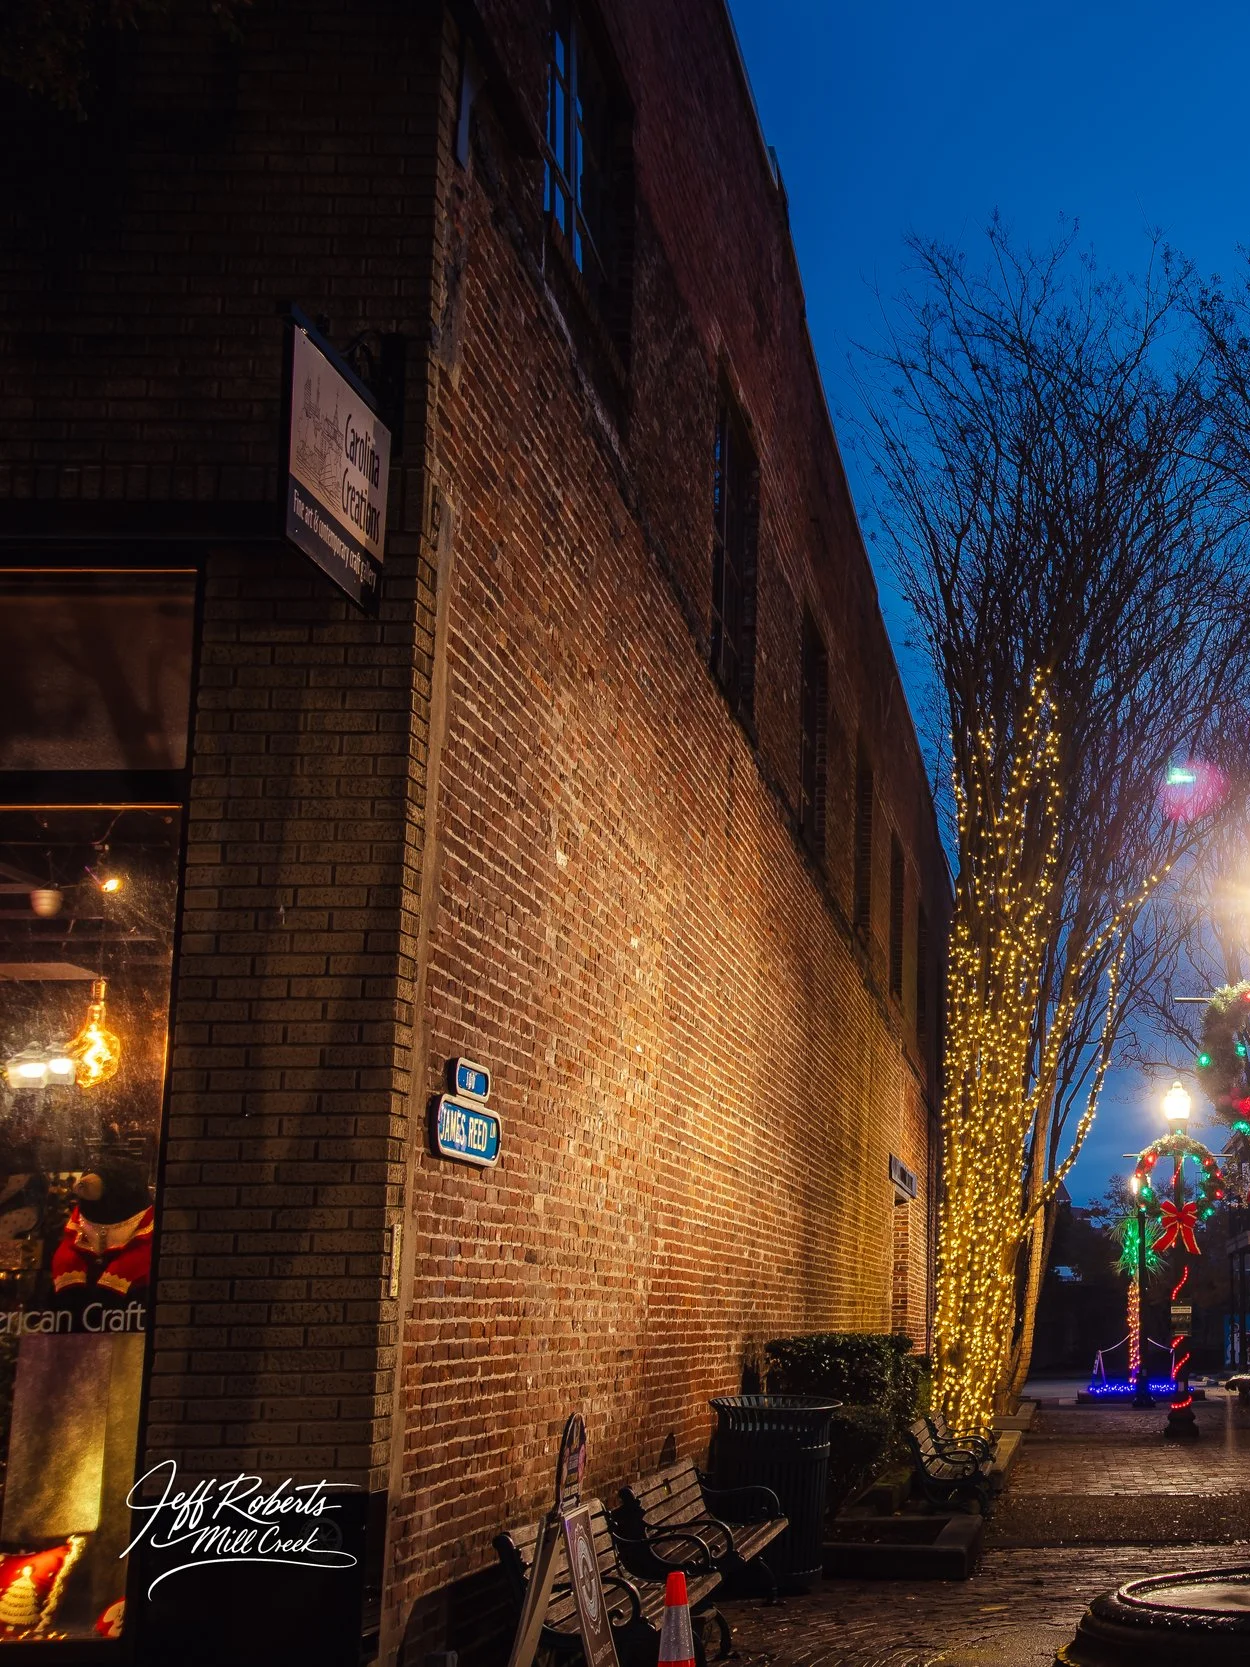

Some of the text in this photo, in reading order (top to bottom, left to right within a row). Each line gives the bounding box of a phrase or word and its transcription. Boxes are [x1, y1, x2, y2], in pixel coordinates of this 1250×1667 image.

[344, 414, 380, 490] Carolina
[293, 489, 304, 520] Fine
[305, 506, 313, 528] art
[319, 520, 350, 568] contemporary
[350, 551, 361, 575] craft
[341, 468, 381, 546] Creations
[440, 1106, 466, 1146] JAMES
[467, 1116, 488, 1152] REED
[82, 1301, 146, 1332] Craft
